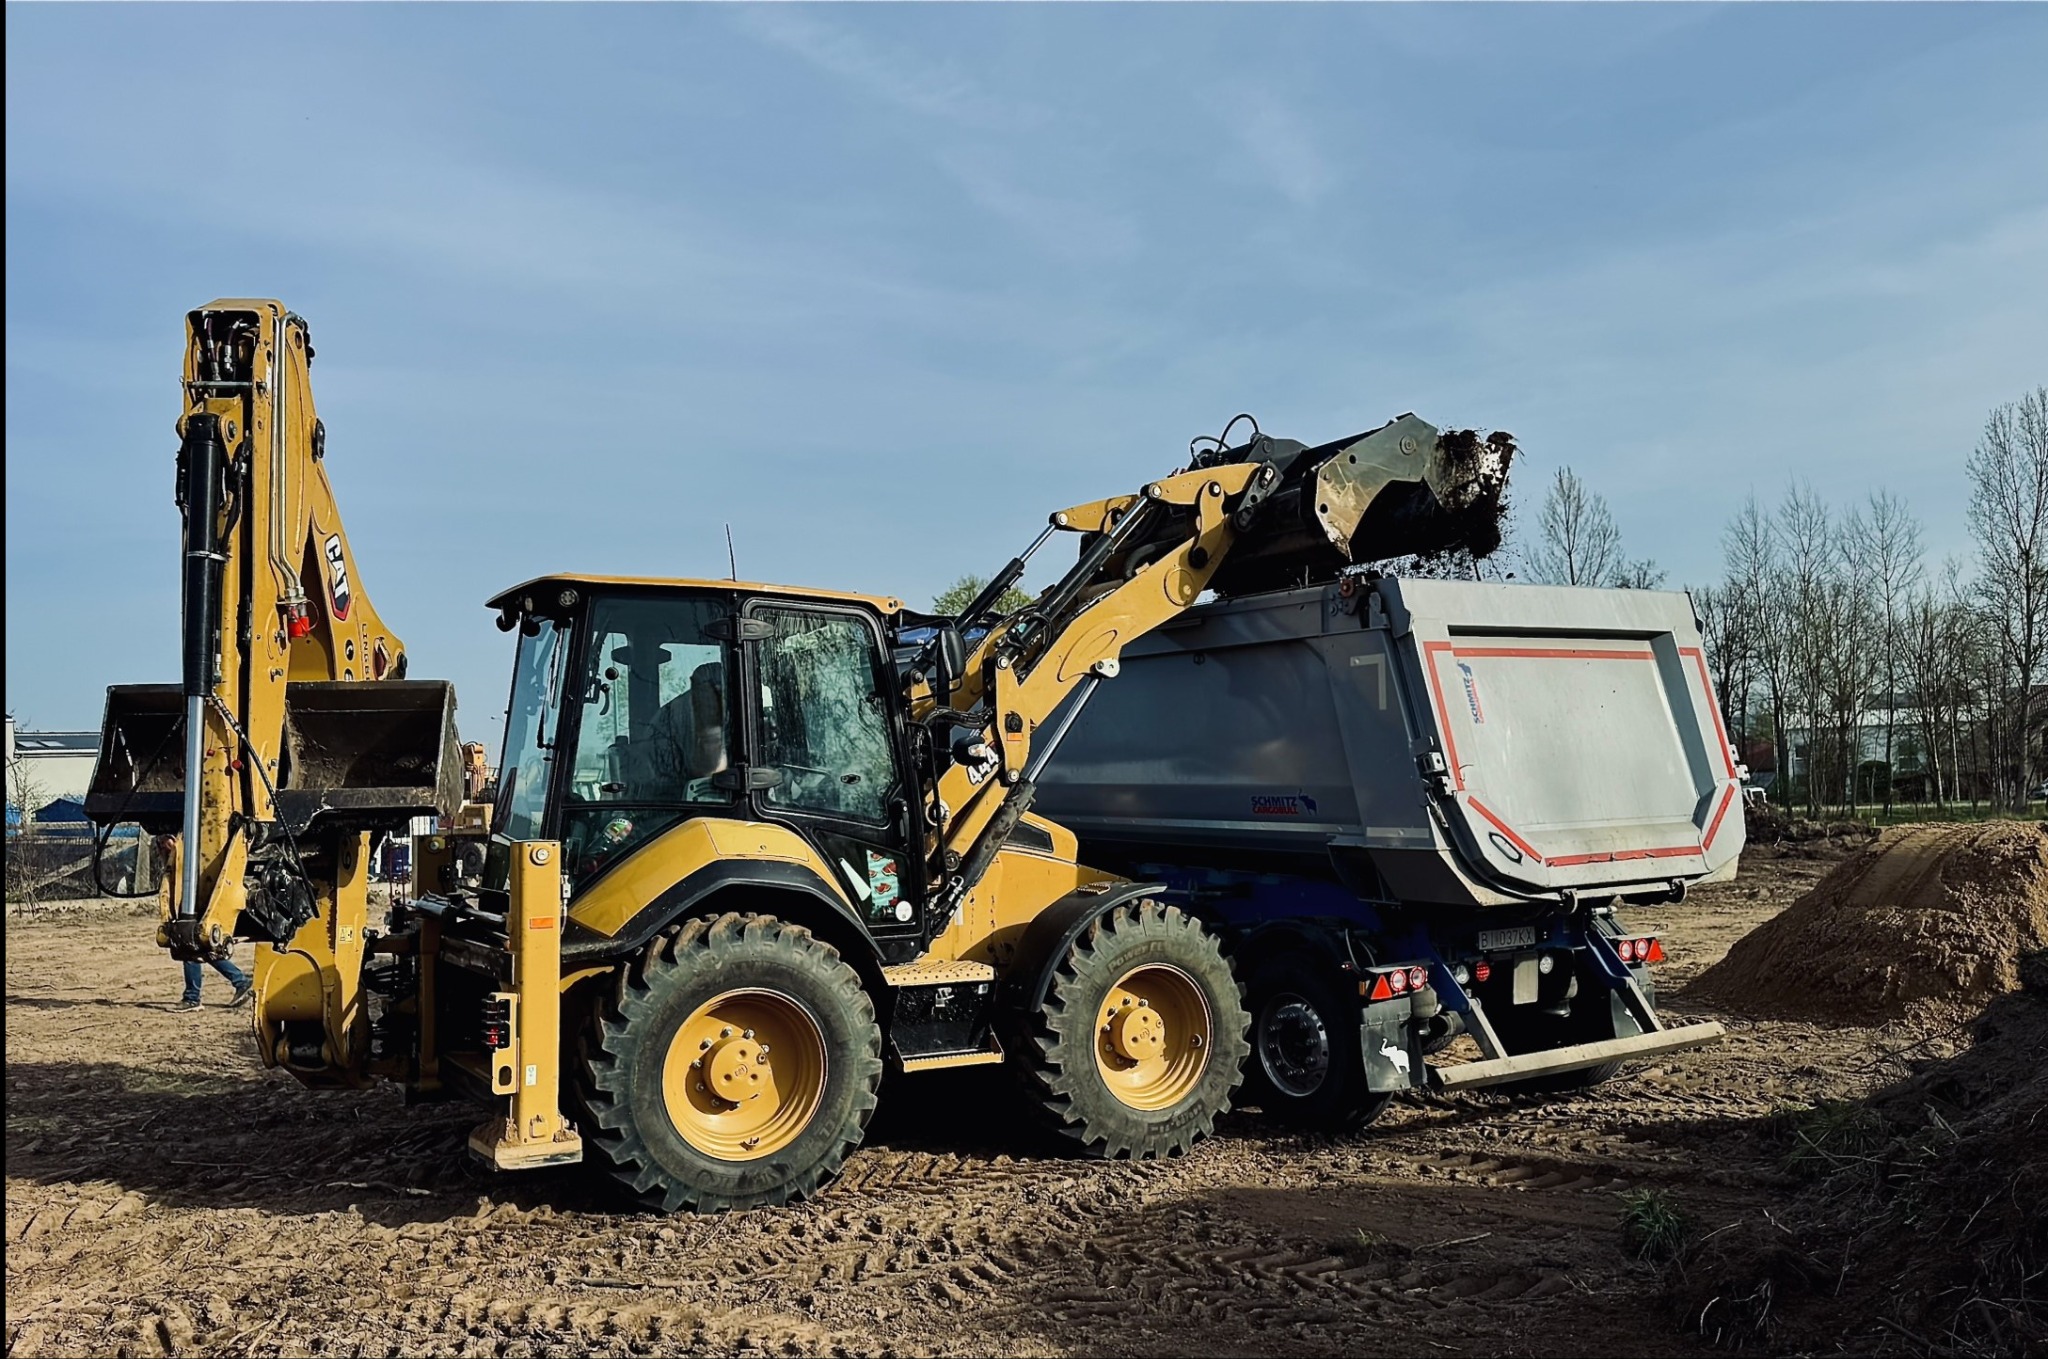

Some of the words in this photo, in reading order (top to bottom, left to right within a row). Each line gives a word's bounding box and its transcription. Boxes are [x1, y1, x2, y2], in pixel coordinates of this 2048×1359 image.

[325, 533, 350, 599] CAT
[1463, 677, 1479, 724] SCHMITZ
[967, 745, 999, 785] 444
[1251, 796, 1298, 807] SCHMITZ
[1481, 931, 1494, 948] BI
